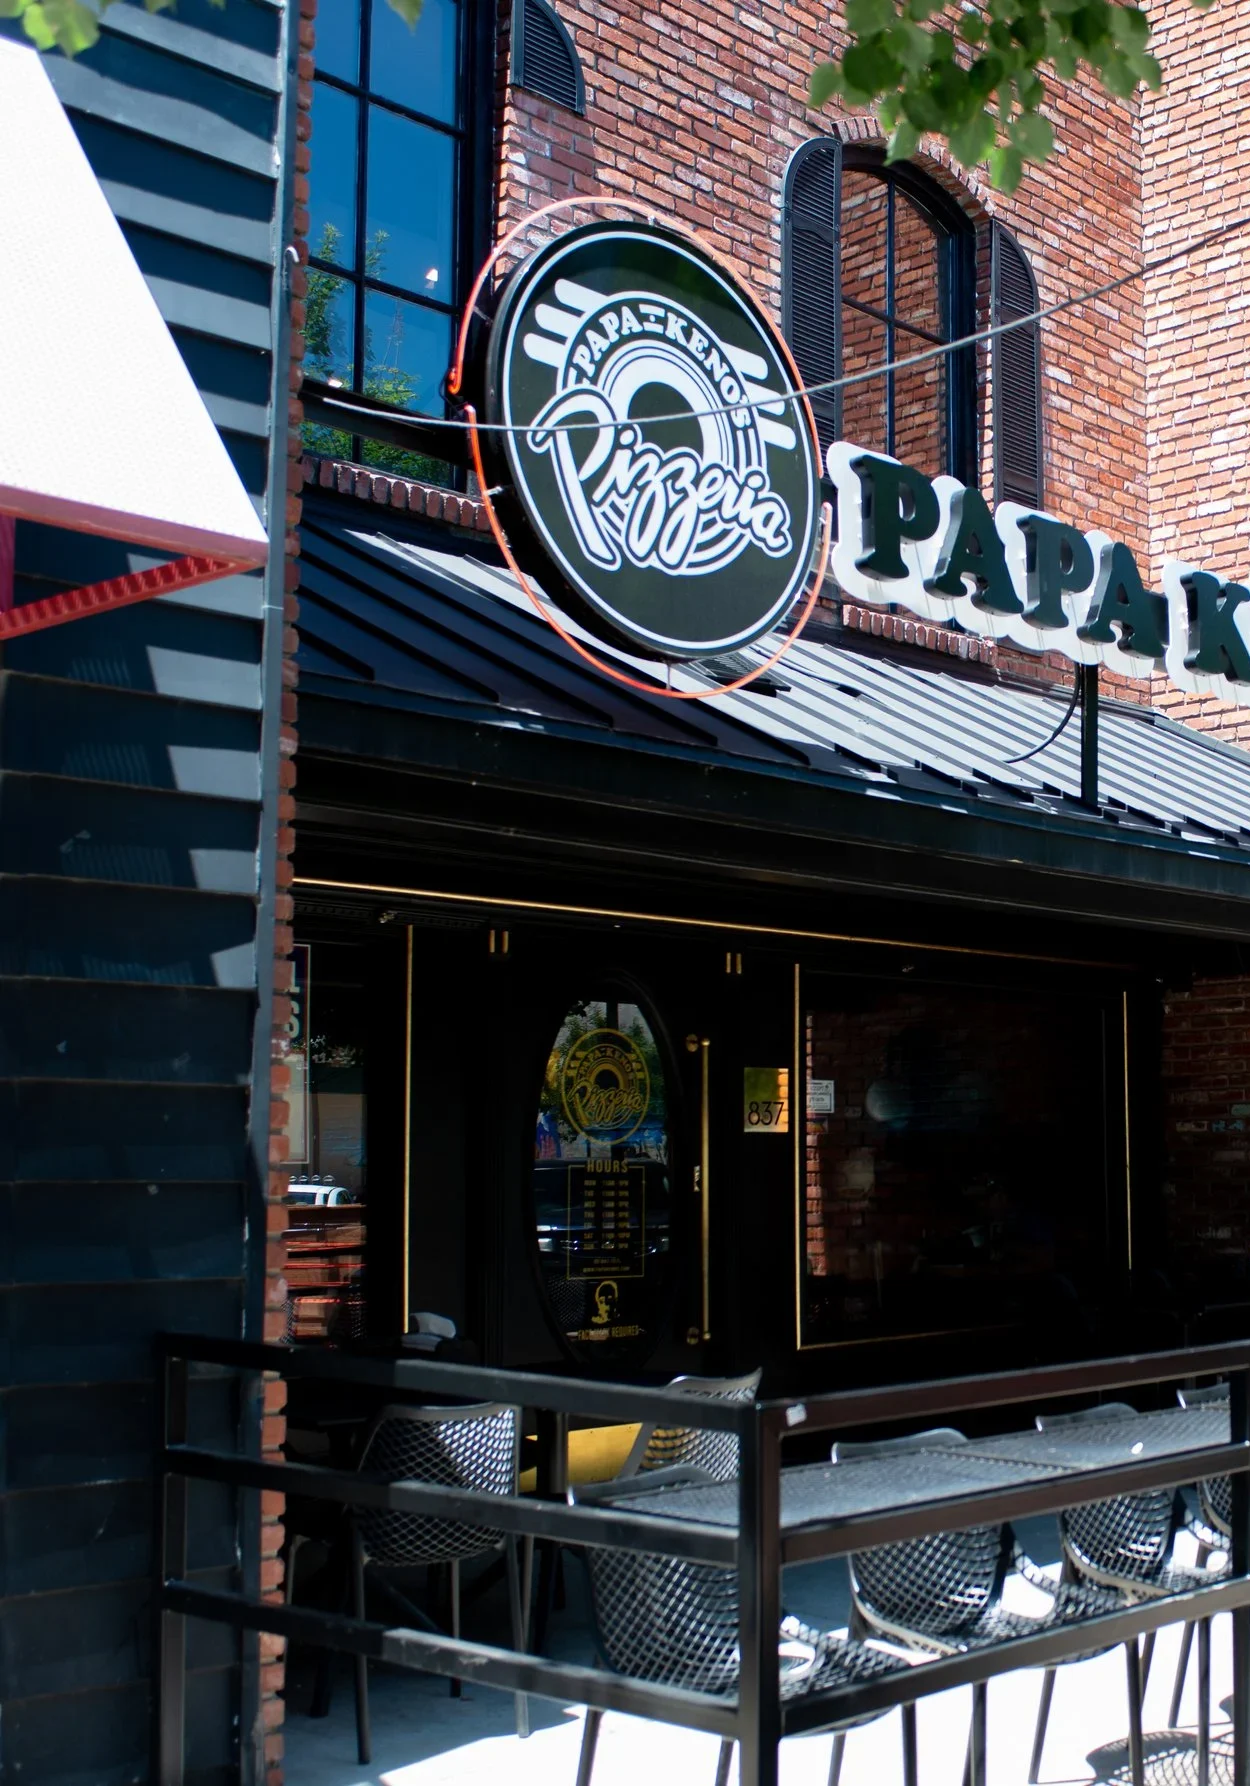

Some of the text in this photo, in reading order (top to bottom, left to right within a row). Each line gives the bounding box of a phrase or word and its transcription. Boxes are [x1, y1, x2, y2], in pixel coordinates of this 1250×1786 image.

[527, 386, 792, 571] Pizzeria
[849, 453, 1164, 659] PAPA
[748, 1101, 784, 1125] 837
[587, 1160, 629, 1173] HOURS
